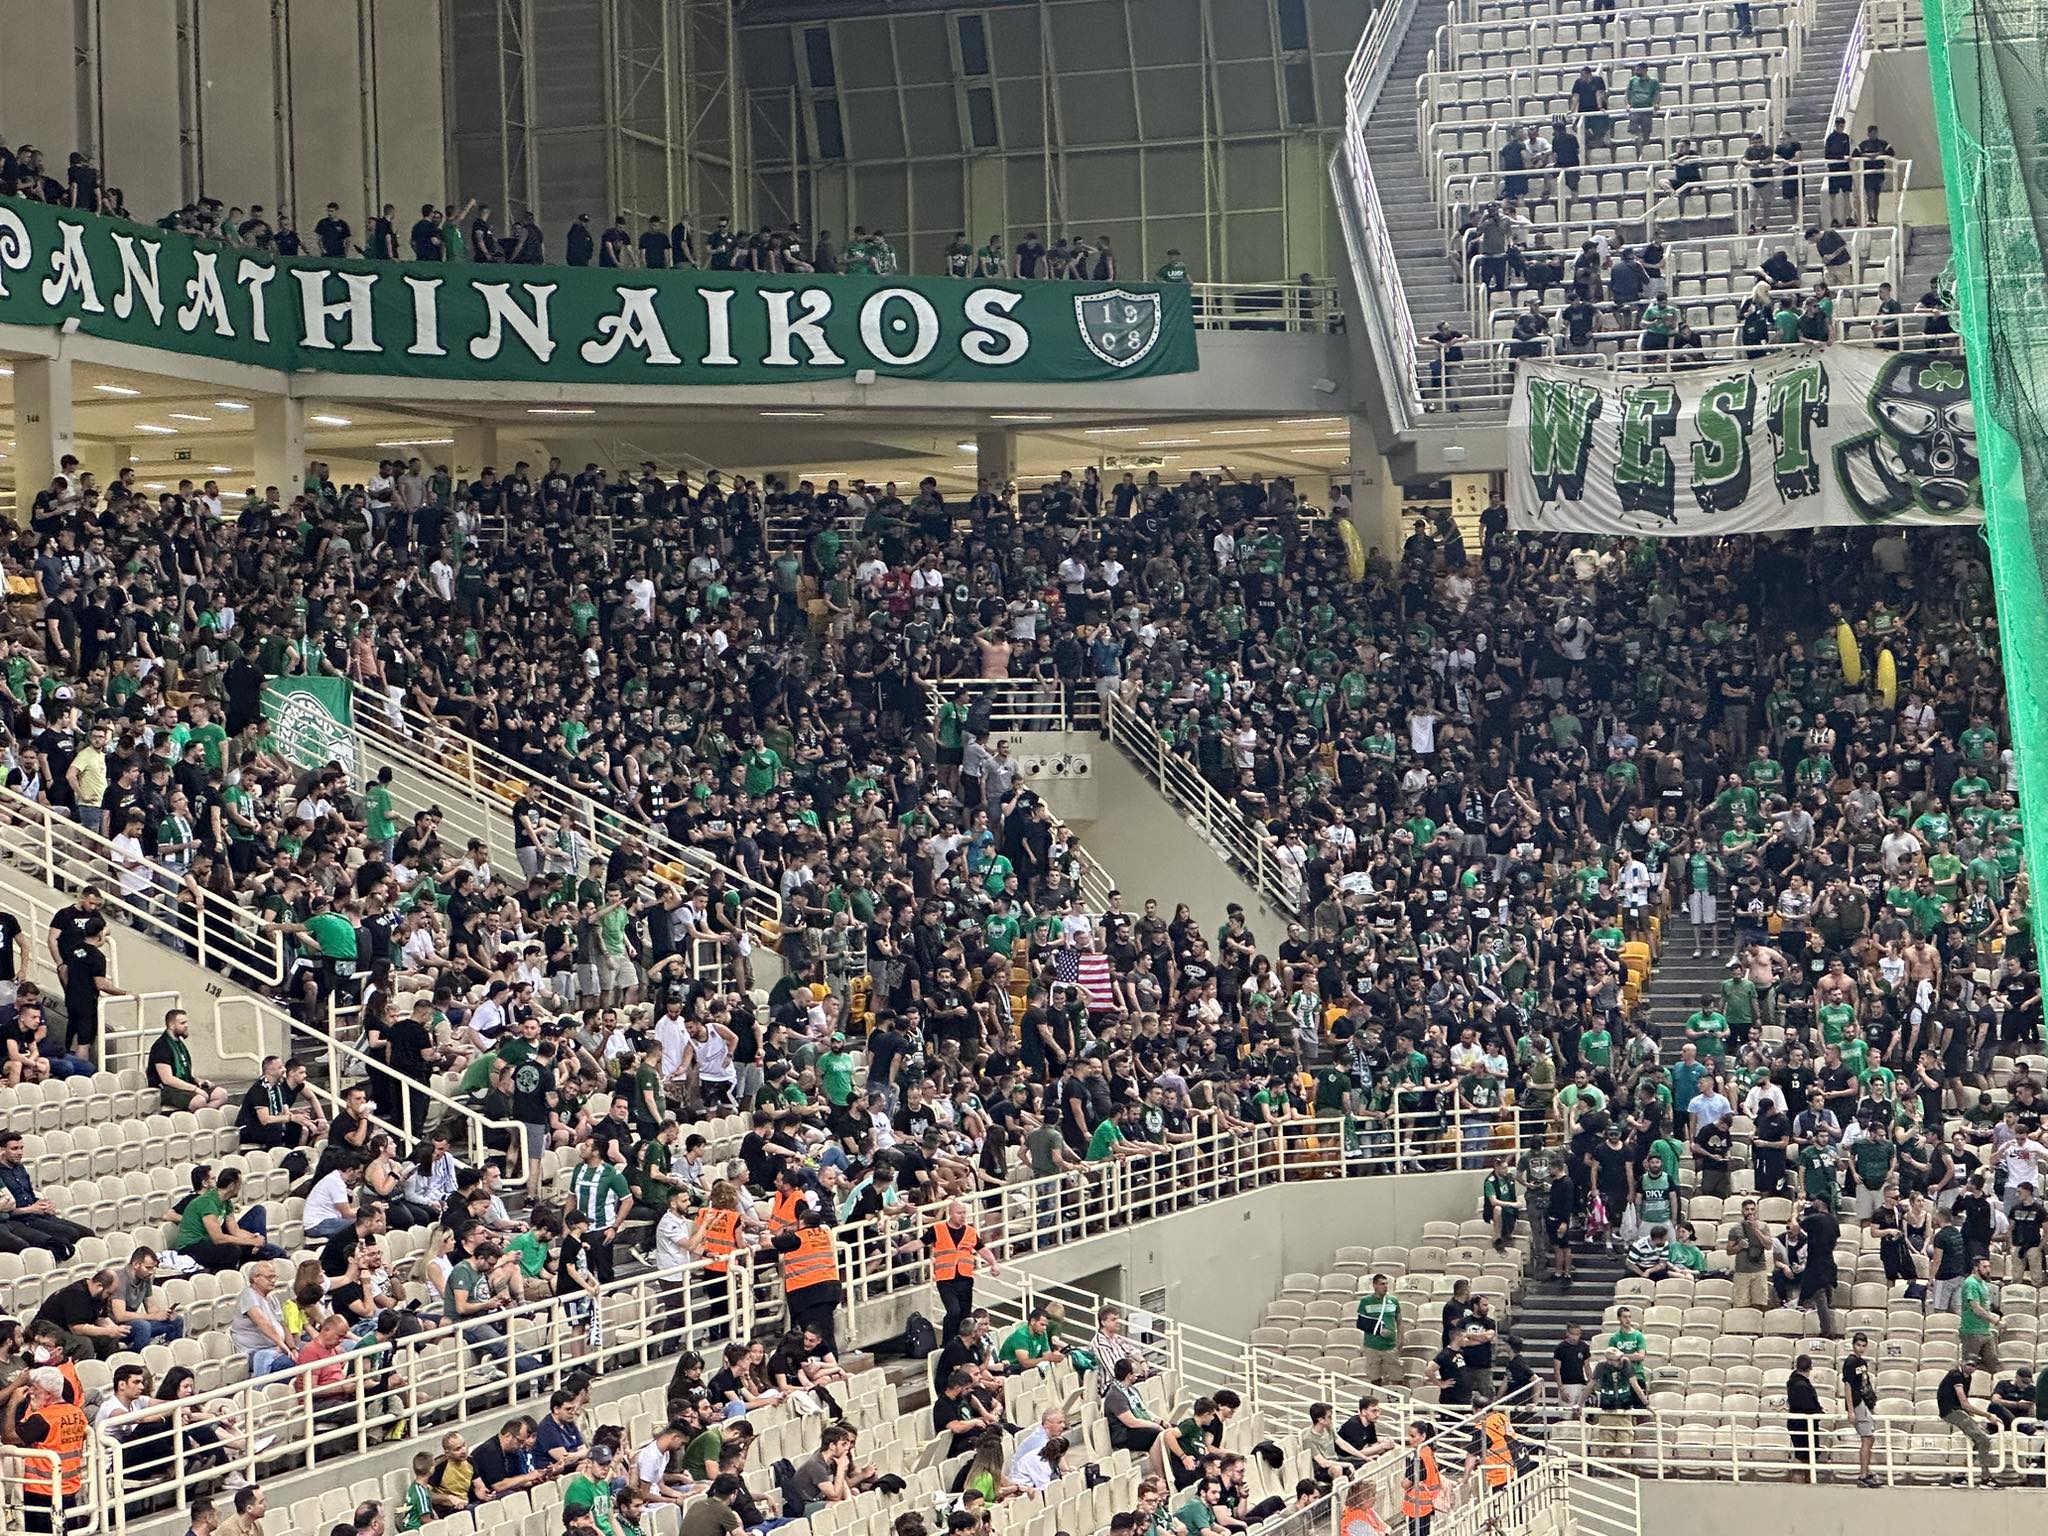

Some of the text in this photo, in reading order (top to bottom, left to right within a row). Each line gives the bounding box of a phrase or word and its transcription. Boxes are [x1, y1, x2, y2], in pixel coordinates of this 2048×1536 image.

[1102, 303, 1138, 324] 19
[1102, 329, 1141, 351] 08
[1527, 360, 1827, 512] WEST
[205, 982, 222, 998] 138
[1791, 1080, 1800, 1089] 13
[1645, 1190, 1664, 1198] DKV
[60, 1413, 85, 1428] ALFA
